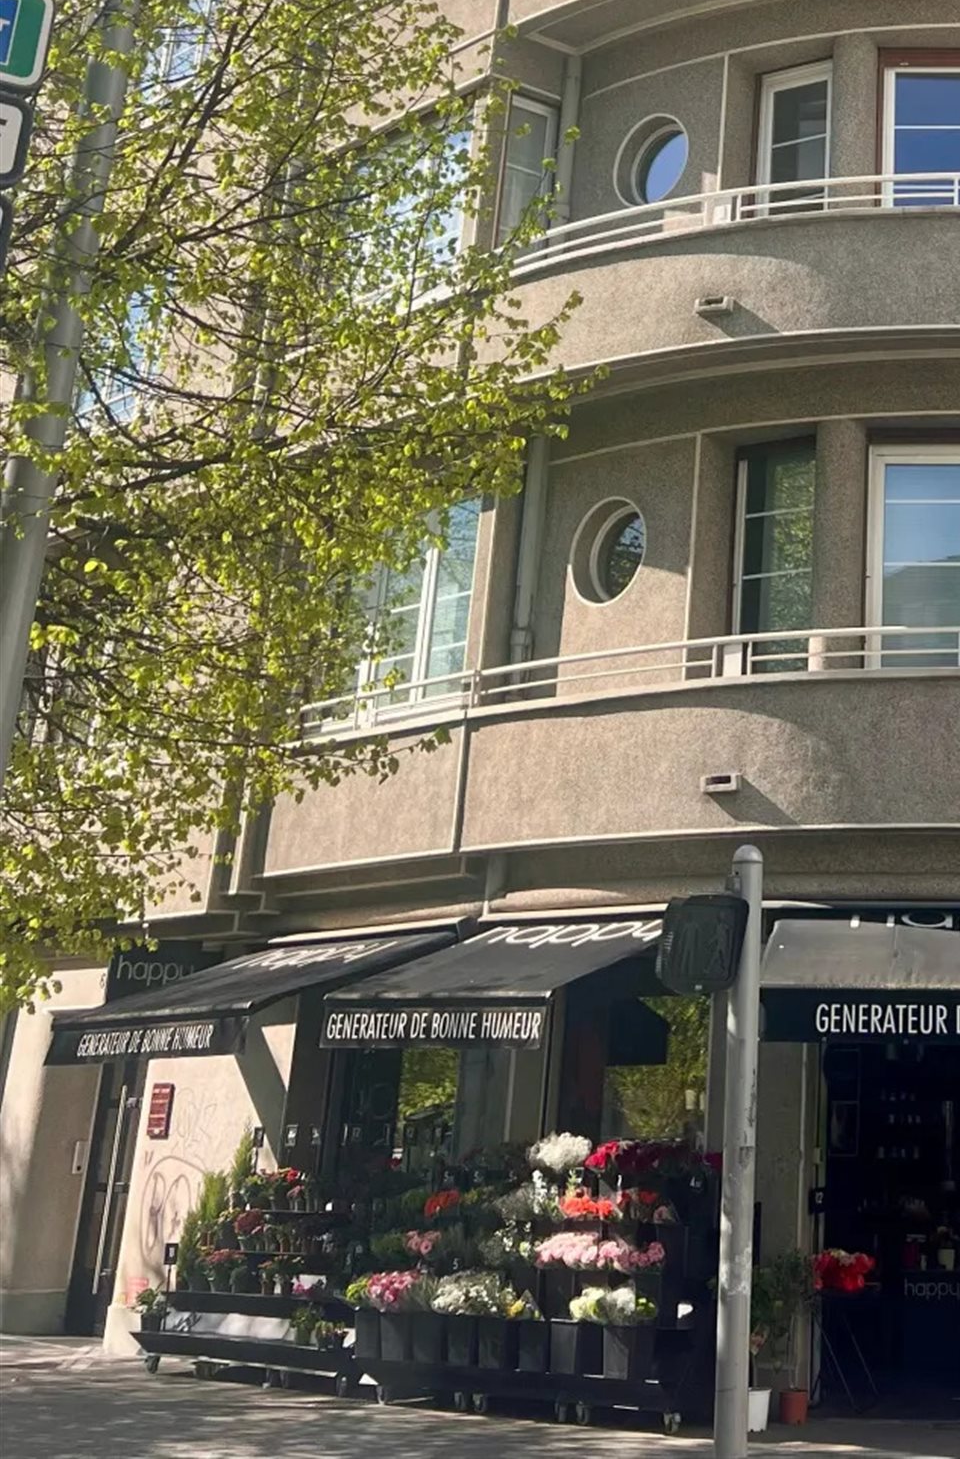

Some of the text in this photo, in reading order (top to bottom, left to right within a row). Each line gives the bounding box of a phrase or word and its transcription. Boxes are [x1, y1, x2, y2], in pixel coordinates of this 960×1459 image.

[326, 1012, 542, 1040] GENERATEUR DE BONNE HUMEUR
[816, 1003, 948, 1035] GENERATEUR
[77, 1030, 130, 1057] GENERATEUR
[127, 1029, 141, 1053] DE
[904, 1278, 960, 1301] happy
